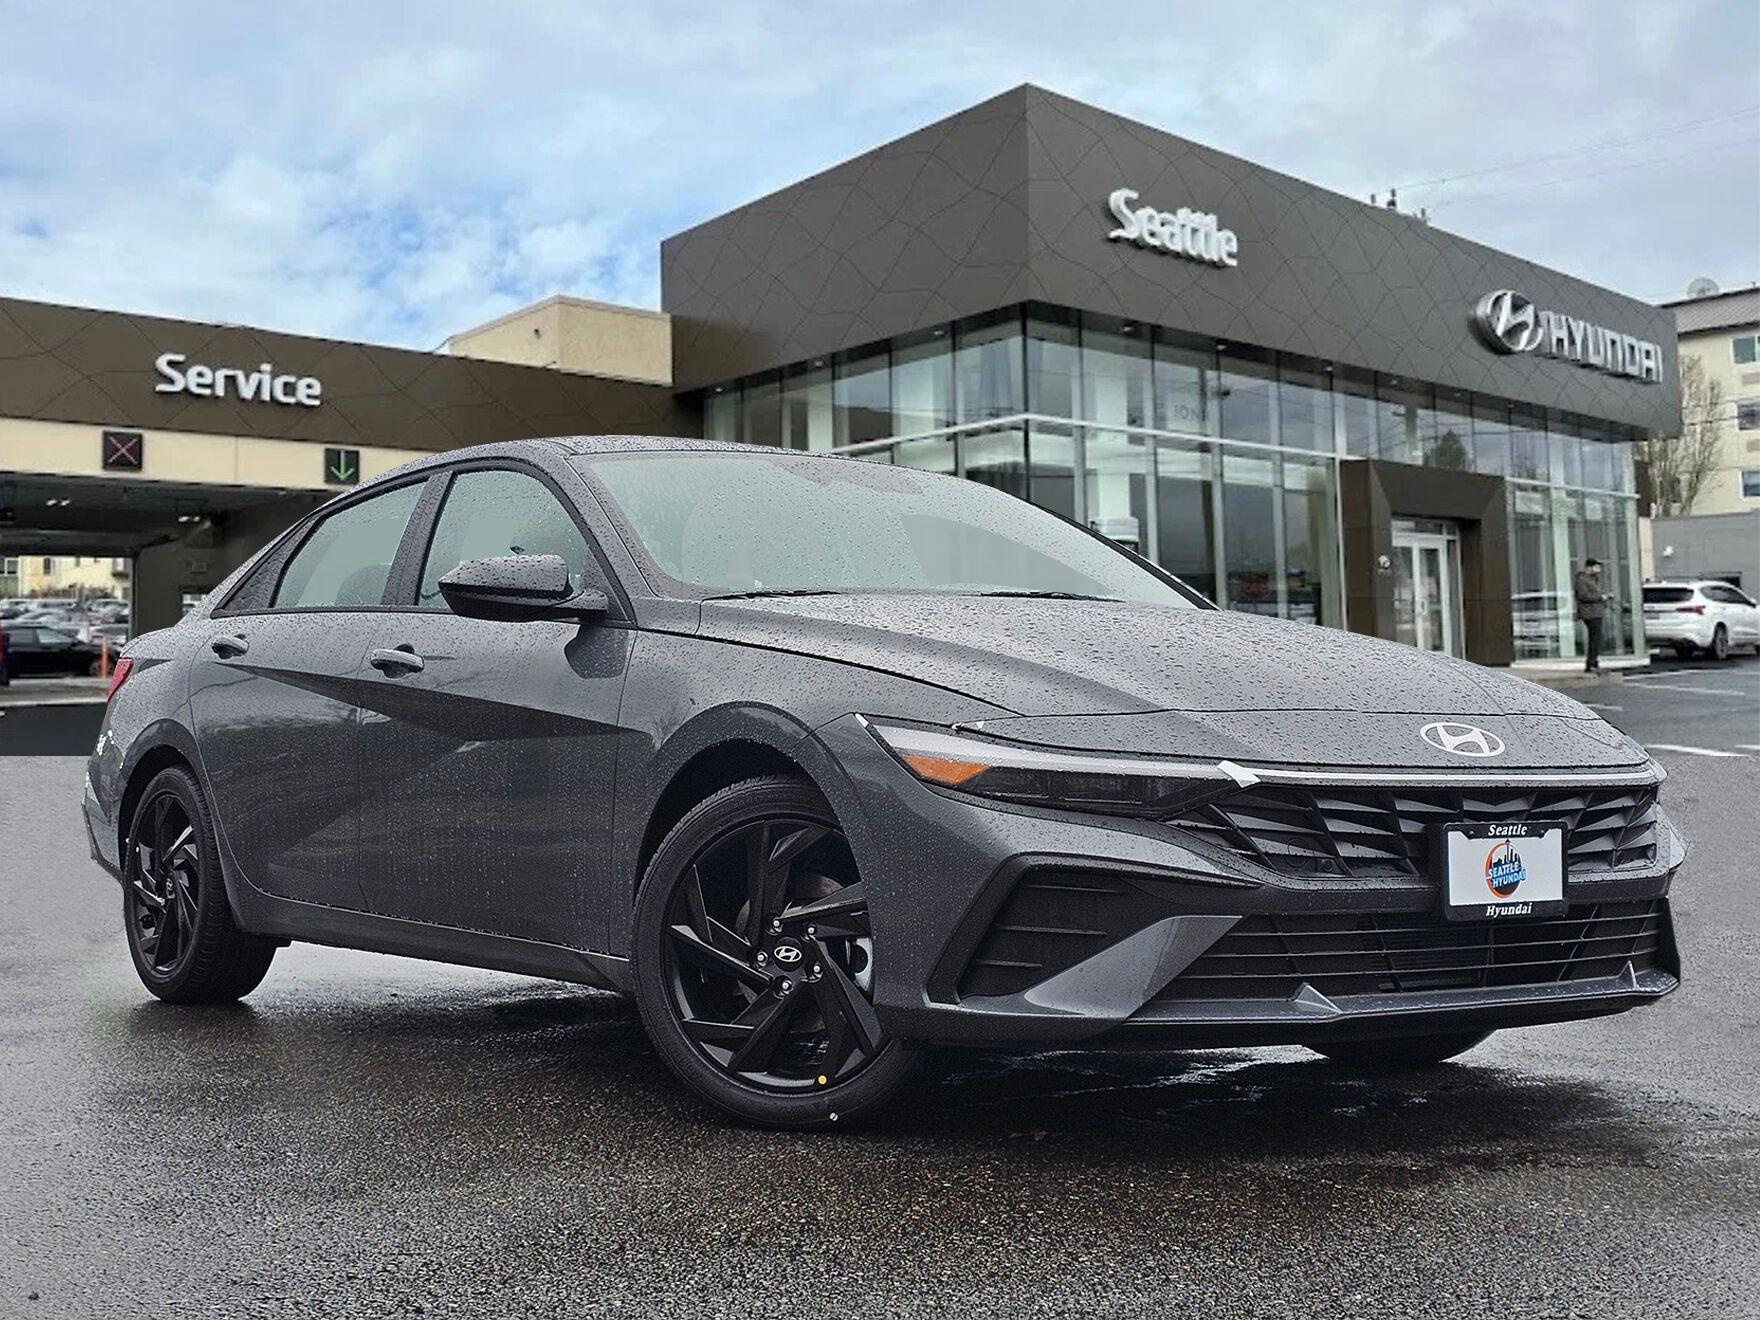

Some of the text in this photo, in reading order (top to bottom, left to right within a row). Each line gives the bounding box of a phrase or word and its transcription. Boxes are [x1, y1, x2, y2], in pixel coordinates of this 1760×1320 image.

[1108, 188, 1238, 267] Seattle
[1541, 311, 1663, 383] HYUNDAI
[155, 353, 322, 406] Service
[1488, 824, 1527, 836] Seattle
[1488, 861, 1520, 879] SEATTLE
[1492, 868, 1527, 888] HYUNDAI
[1486, 902, 1532, 918] Hyundai
